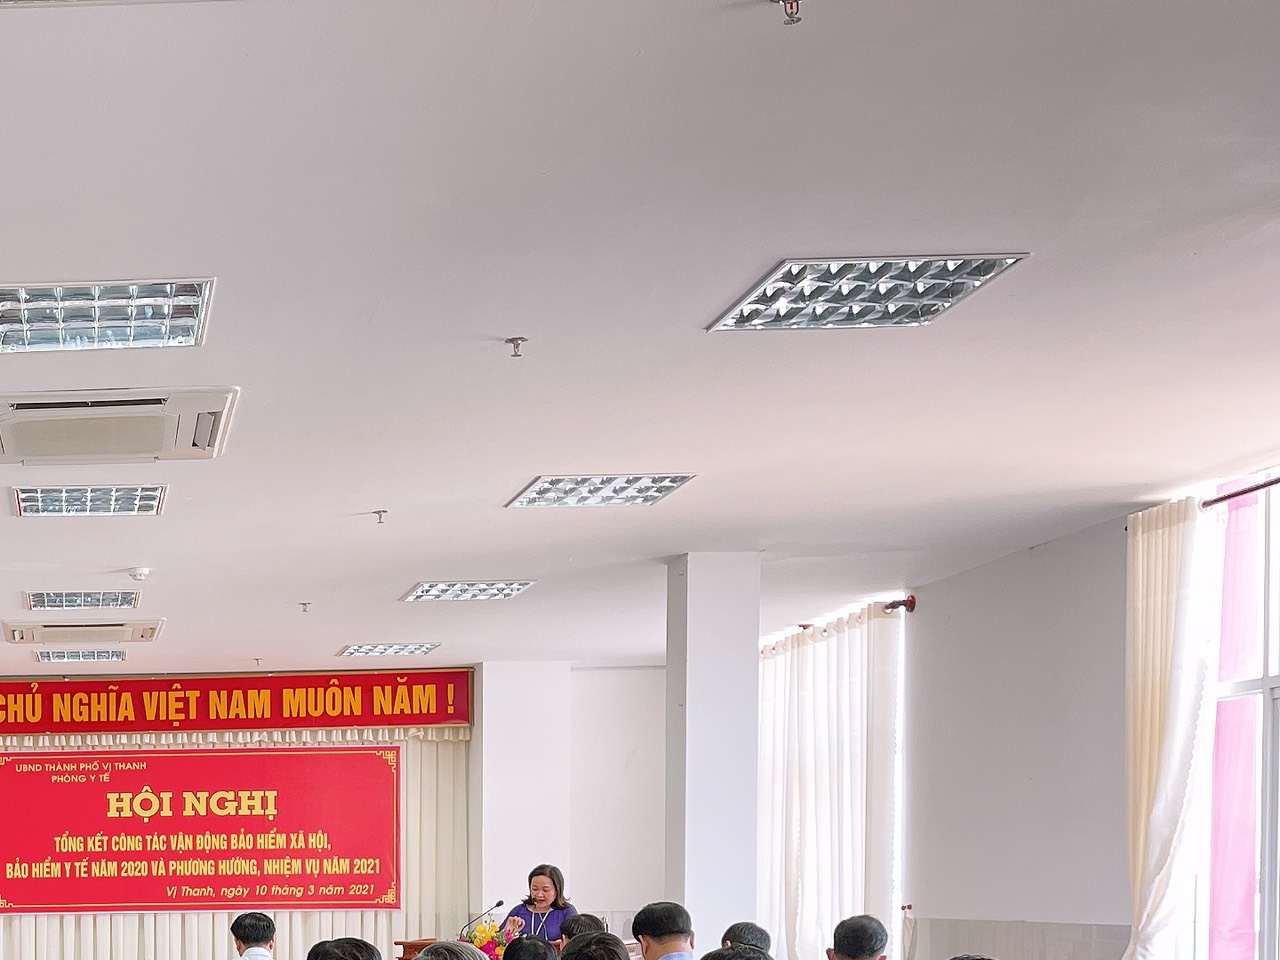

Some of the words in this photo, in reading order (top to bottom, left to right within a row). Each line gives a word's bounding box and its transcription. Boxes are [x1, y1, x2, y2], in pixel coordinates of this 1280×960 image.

[52, 685, 135, 722] NGHĨA
[142, 683, 200, 727] VIỆT
[209, 689, 271, 720] NAM
[283, 678, 362, 718] MUÔN
[373, 676, 436, 716] NĂM
[15, 764, 42, 772] UBND
[44, 762, 77, 772] THÀNH
[80, 760, 100, 771] PHỐ
[102, 763, 112, 772] VỊ
[114, 762, 147, 771] THANH
[51, 773, 87, 783] PHÒNG
[90, 774, 96, 782] Y
[99, 772, 110, 782] TẾ
[106, 785, 173, 823] HỘI
[182, 790, 278, 821] NGHỊ
[54, 830, 84, 852] TỔNG
[87, 831, 108, 852] KẾT
[112, 832, 142, 851] CÔNG
[146, 832, 167, 851] TÁC
[170, 832, 193, 854] VẬN
[196, 831, 227, 853] ĐỘNG
[231, 828, 253, 850] BẢO
[257, 827, 286, 849] HIỂM
[290, 830, 306, 849] XÃ
[309, 830, 331, 852] HỘI,
[6, 857, 28, 878] BẢO
[32, 856, 61, 878] HIỂM
[64, 862, 71, 877] Y
[74, 857, 89, 877] TẾ
[91, 859, 118, 877] NĂM
[121, 861, 148, 876] 2020
[151, 857, 166, 876] VÀ
[169, 858, 215, 876] PHƯƠNG
[218, 856, 261, 877] HƯỚNG,
[264, 856, 302, 878] NHIỆM
[305, 859, 320, 878] VỤ
[323, 855, 350, 875] NĂM
[353, 858, 380, 874] 2021
[166, 886, 178, 899] Vị
[181, 886, 215, 898] Thanh,
[220, 885, 250, 899] ngày
[255, 885, 268, 895] 10
[271, 884, 304, 898] tháng
[308, 885, 315, 895] 3
[319, 884, 345, 895] năm
[349, 884, 375, 895] 2021
